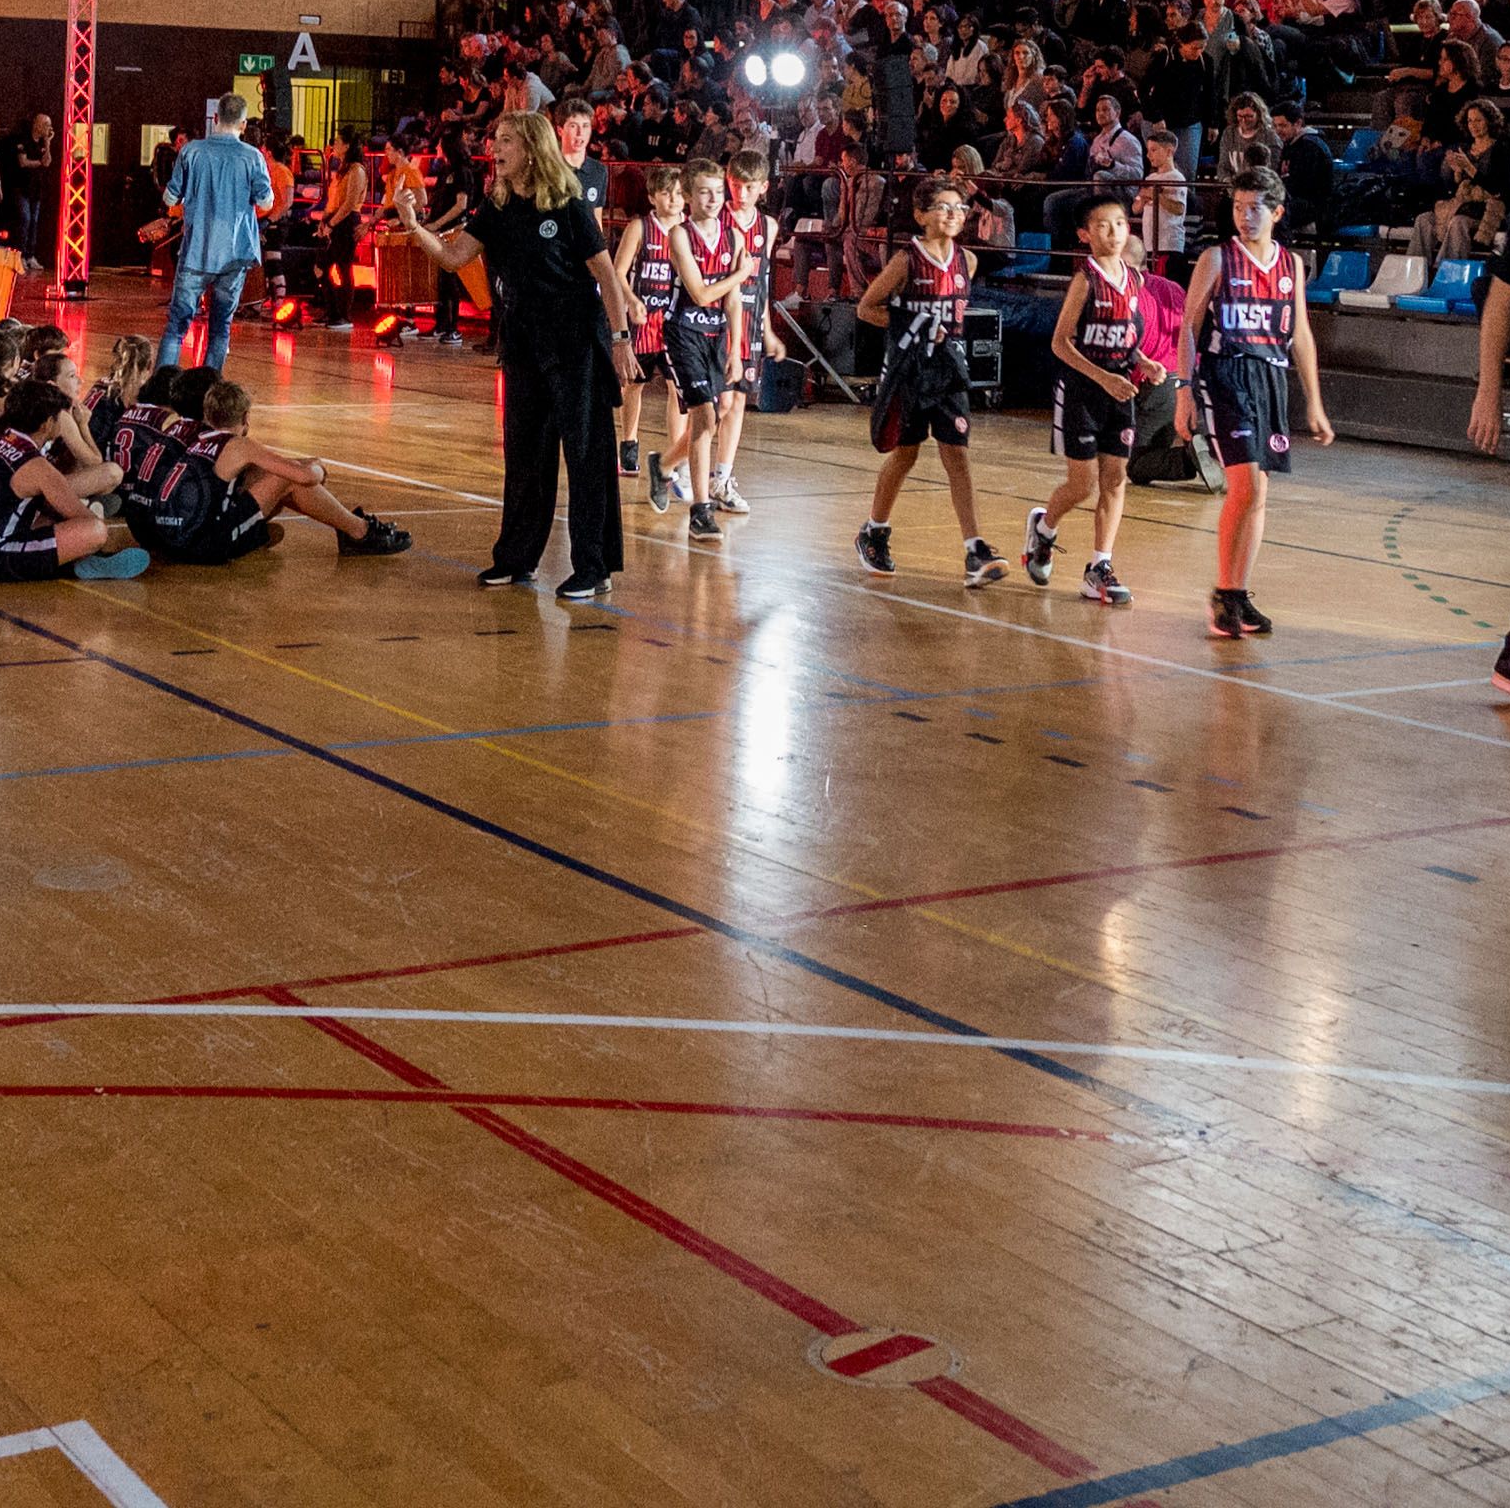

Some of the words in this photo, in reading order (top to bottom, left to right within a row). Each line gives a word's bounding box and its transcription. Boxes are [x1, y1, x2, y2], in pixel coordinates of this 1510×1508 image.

[288, 32, 321, 71] A
[1222, 303, 1273, 331] UESC
[1083, 322, 1126, 348] UESC
